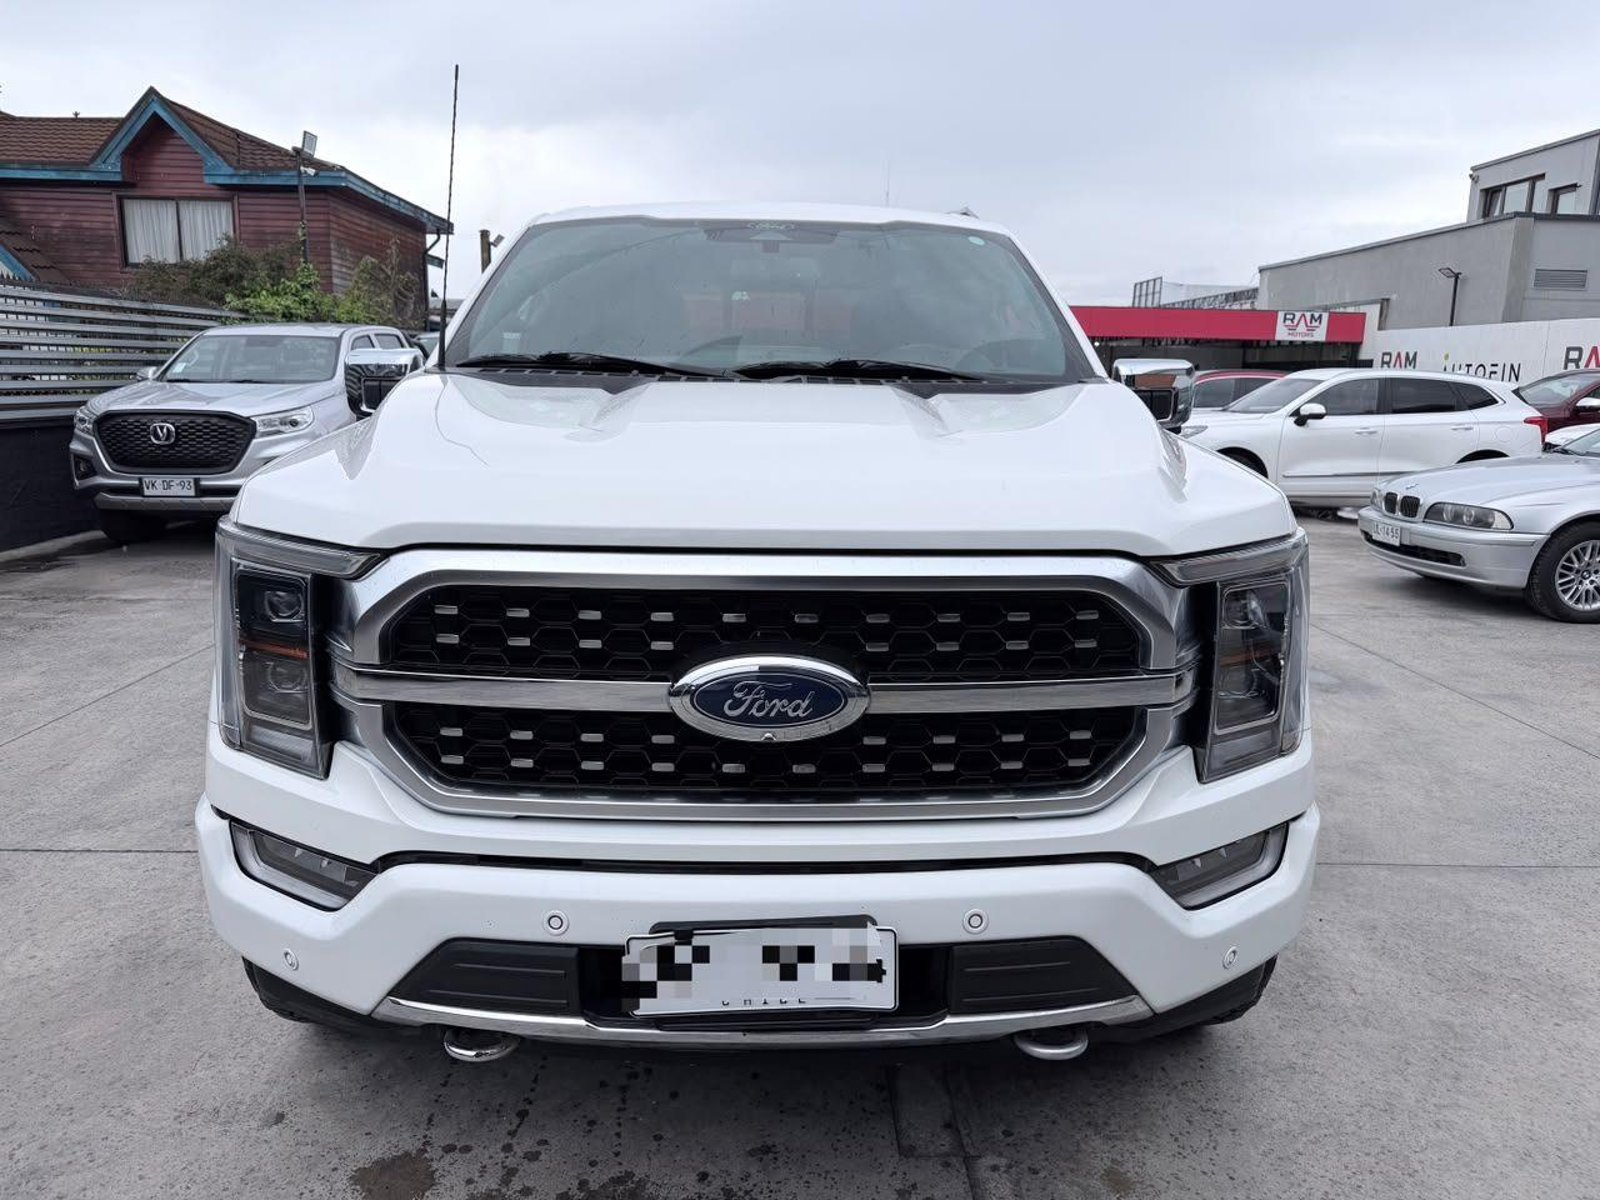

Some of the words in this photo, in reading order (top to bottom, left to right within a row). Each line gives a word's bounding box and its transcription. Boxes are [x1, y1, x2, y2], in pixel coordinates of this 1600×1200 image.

[1283, 312, 1323, 327] RAM
[1380, 351, 1418, 369] RAM
[723, 680, 815, 718] Ford
